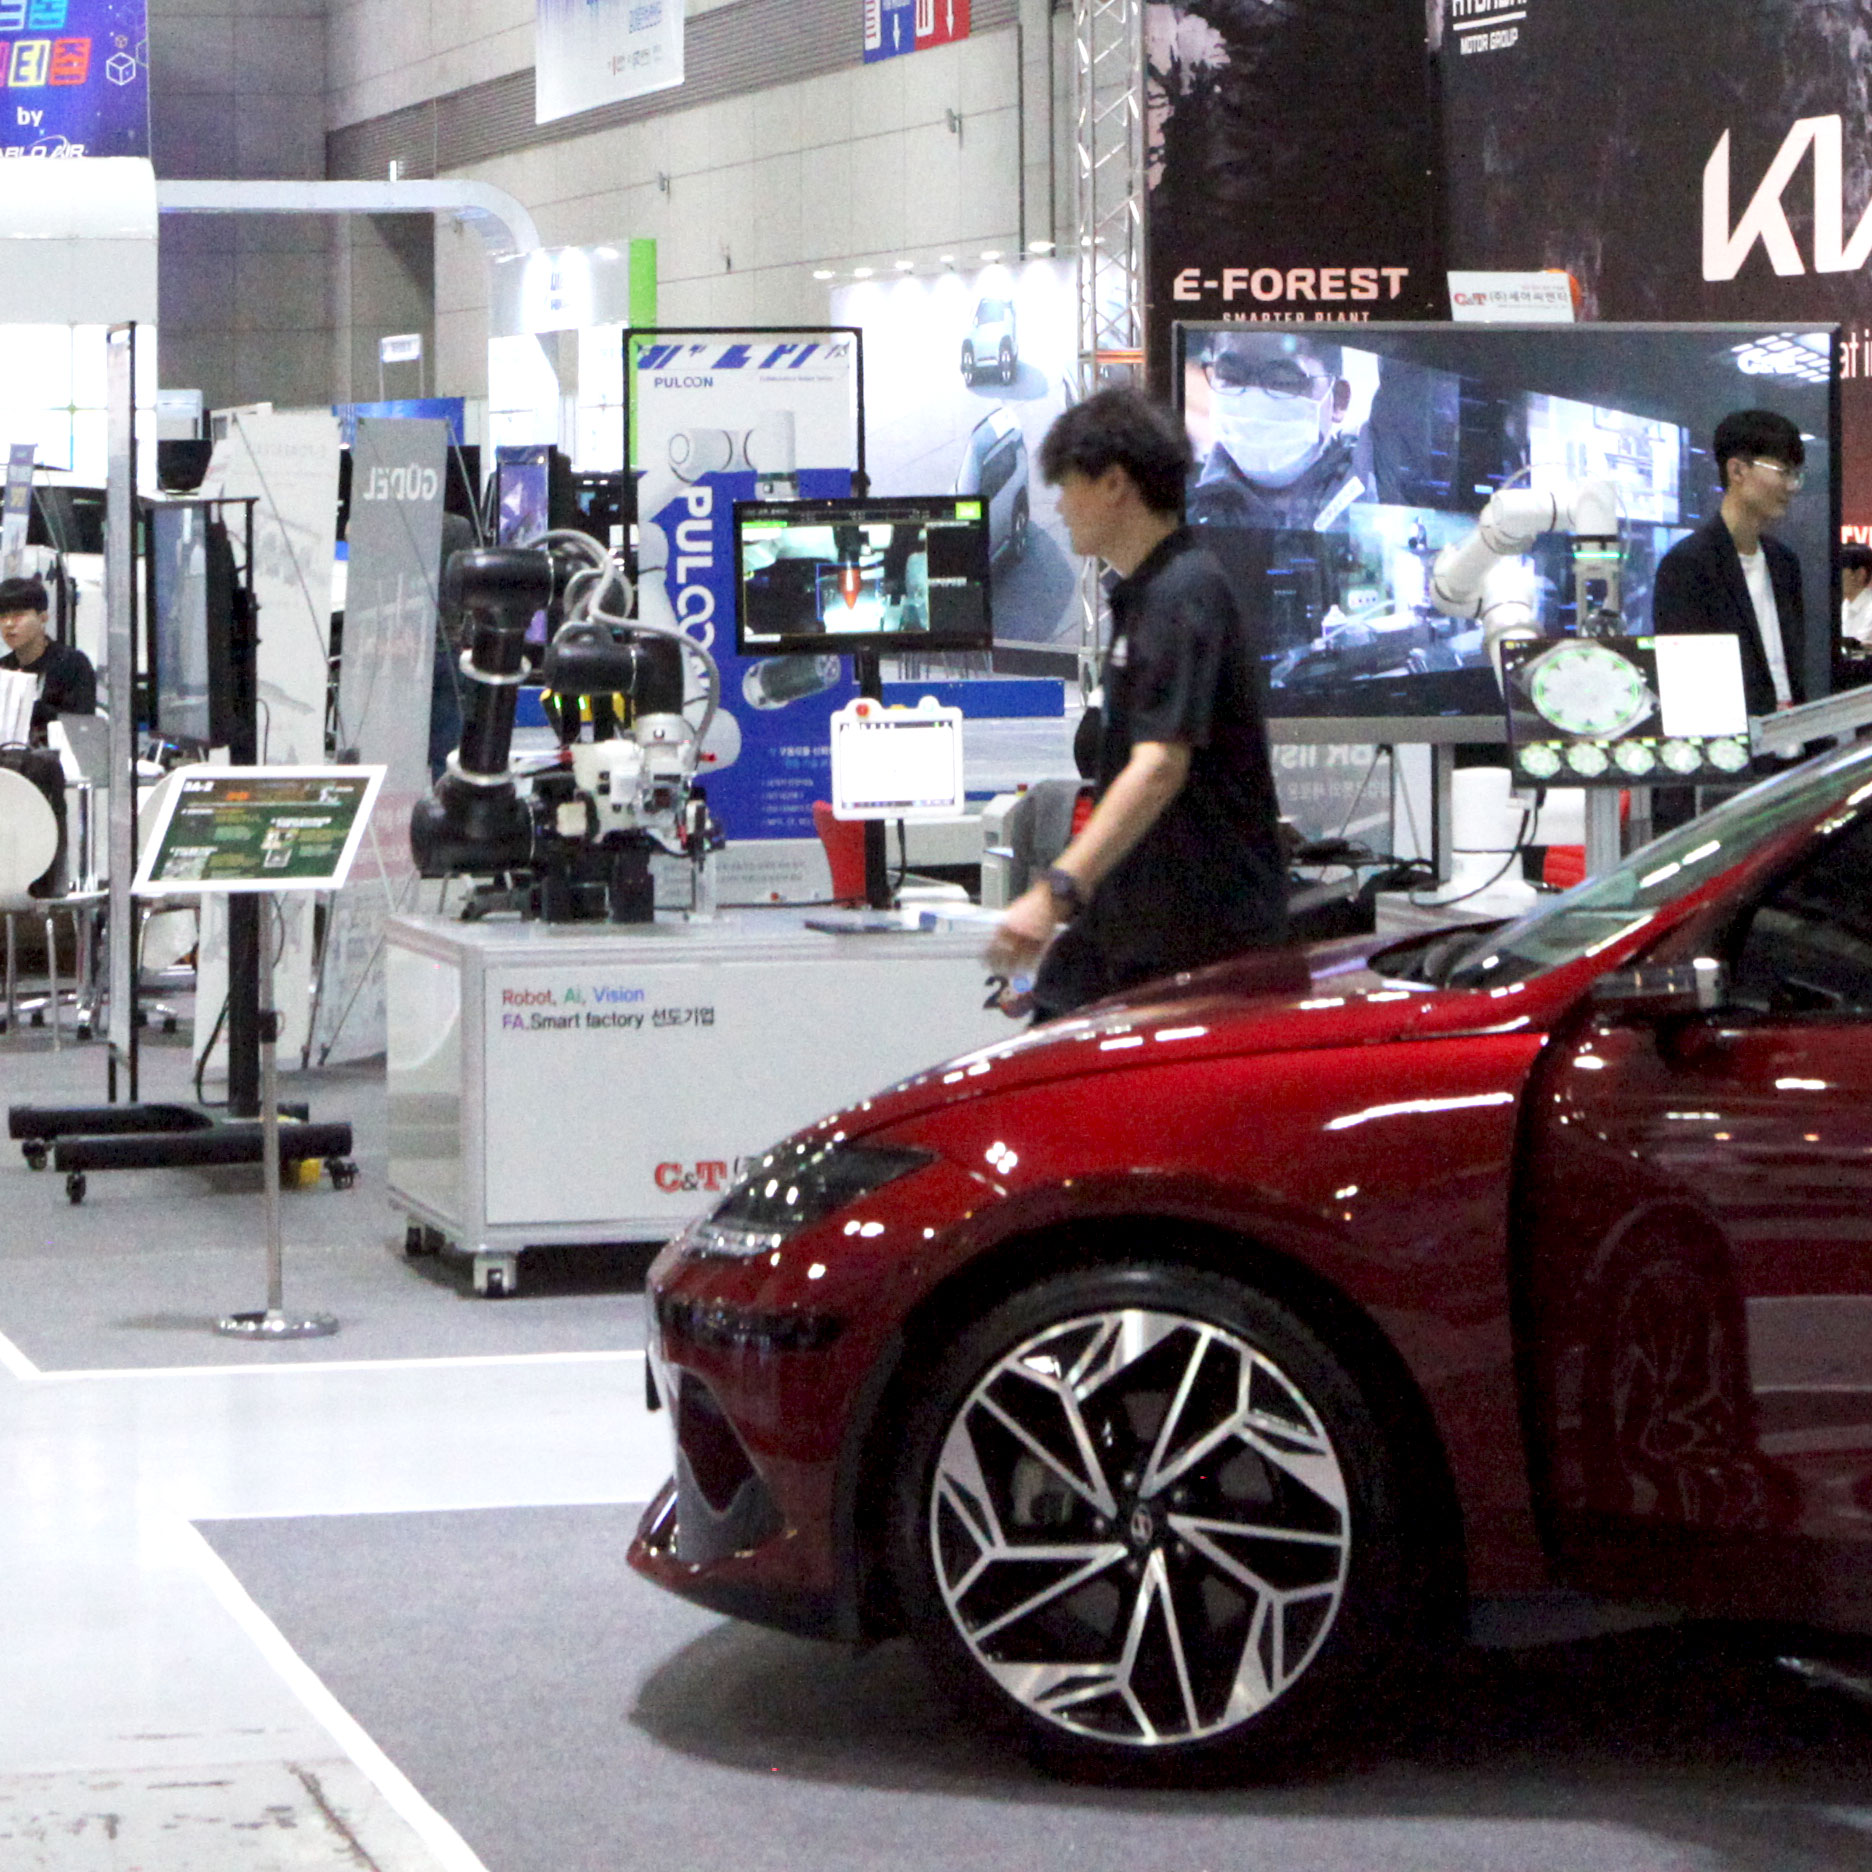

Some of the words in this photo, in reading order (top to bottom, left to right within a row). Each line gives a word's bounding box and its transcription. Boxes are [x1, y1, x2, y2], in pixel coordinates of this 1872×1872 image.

[16, 105, 43, 127] by
[1173, 267, 1409, 301] E-FOREST
[654, 376, 714, 389] PULOON
[593, 985, 645, 1004] Vision
[585, 1011, 644, 1030] factory
[651, 1006, 715, 1027] 선도기업
[654, 1160, 728, 1194] C&T
